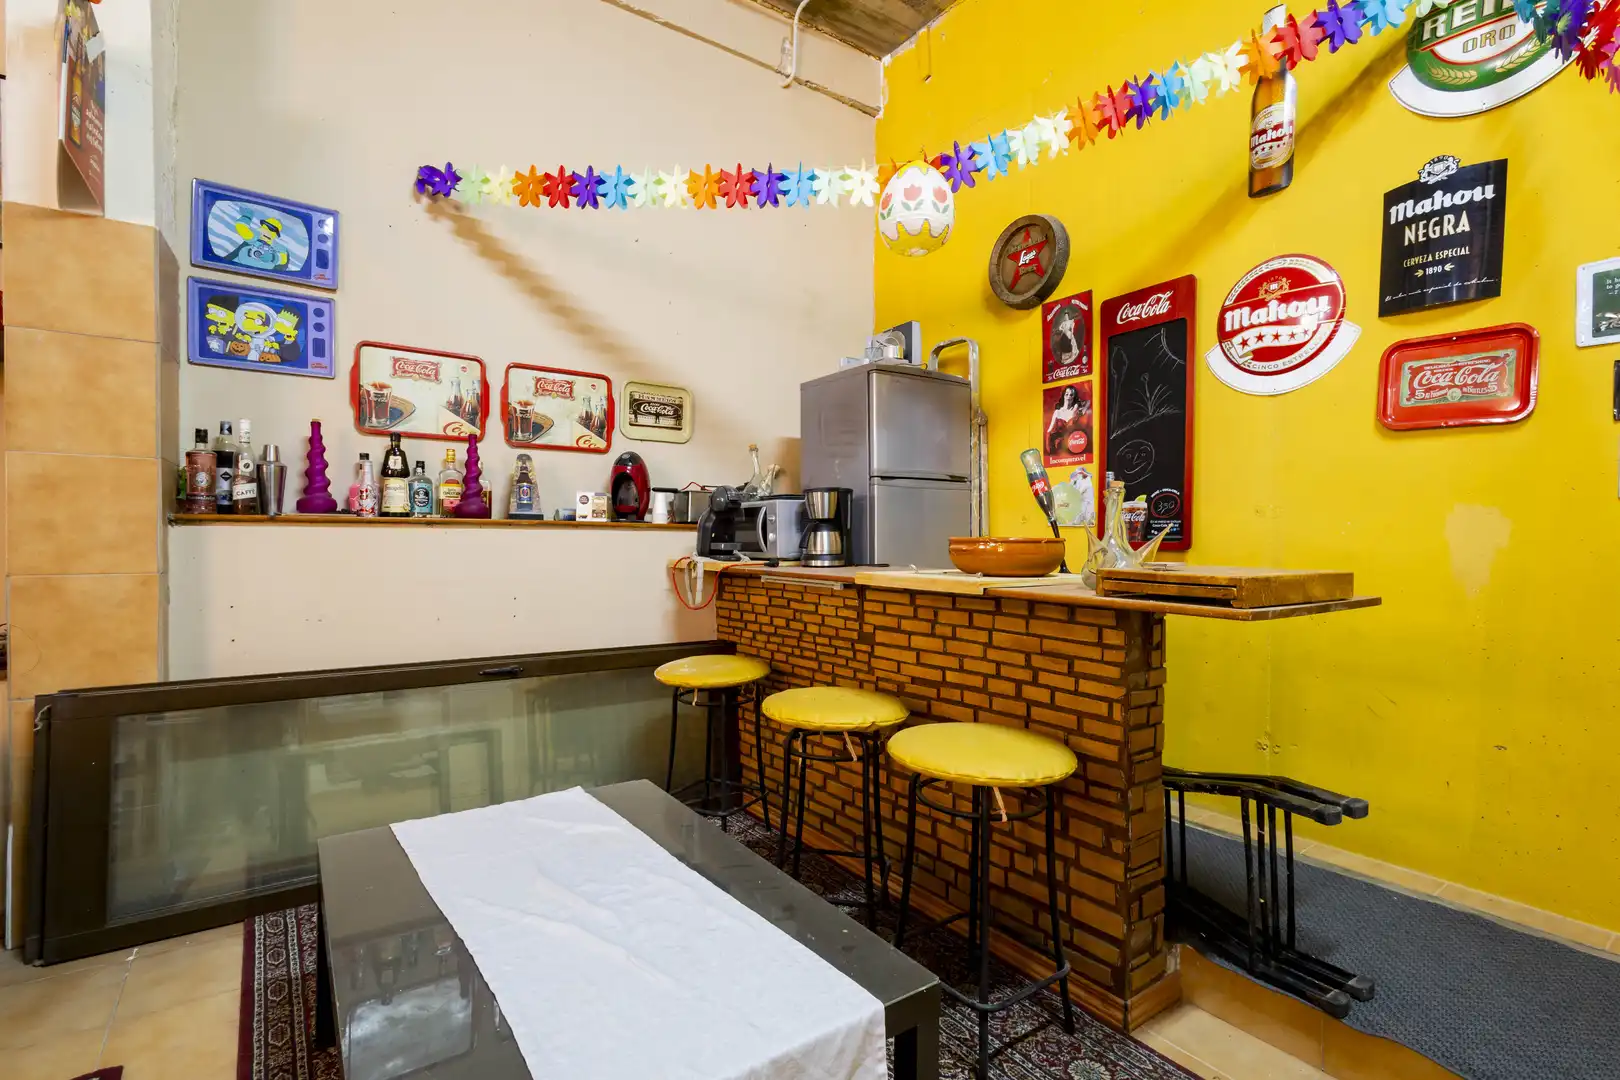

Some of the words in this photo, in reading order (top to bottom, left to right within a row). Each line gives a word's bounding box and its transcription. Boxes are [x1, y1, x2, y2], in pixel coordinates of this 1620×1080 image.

[1462, 23, 1516, 54] ORO
[1389, 184, 1496, 225] Mahou
[1403, 210, 1471, 246] NEGRA
[1403, 253, 1433, 268] CERVEZA
[1435, 246, 1470, 260] ESPECIAL
[1425, 265, 1443, 276] 1890
[1116, 290, 1174, 325] Coca-Cola
[1224, 296, 1332, 332] Mahou
[395, 360, 437, 375] Coca-Cola
[1053, 365, 1080, 380] Coca-Cola
[1252, 363, 1279, 371] CINCO
[1413, 361, 1504, 389] Coca-Cola
[537, 381, 571, 394] Coca-Cola
[640, 402, 675, 416] Coca-Cola
